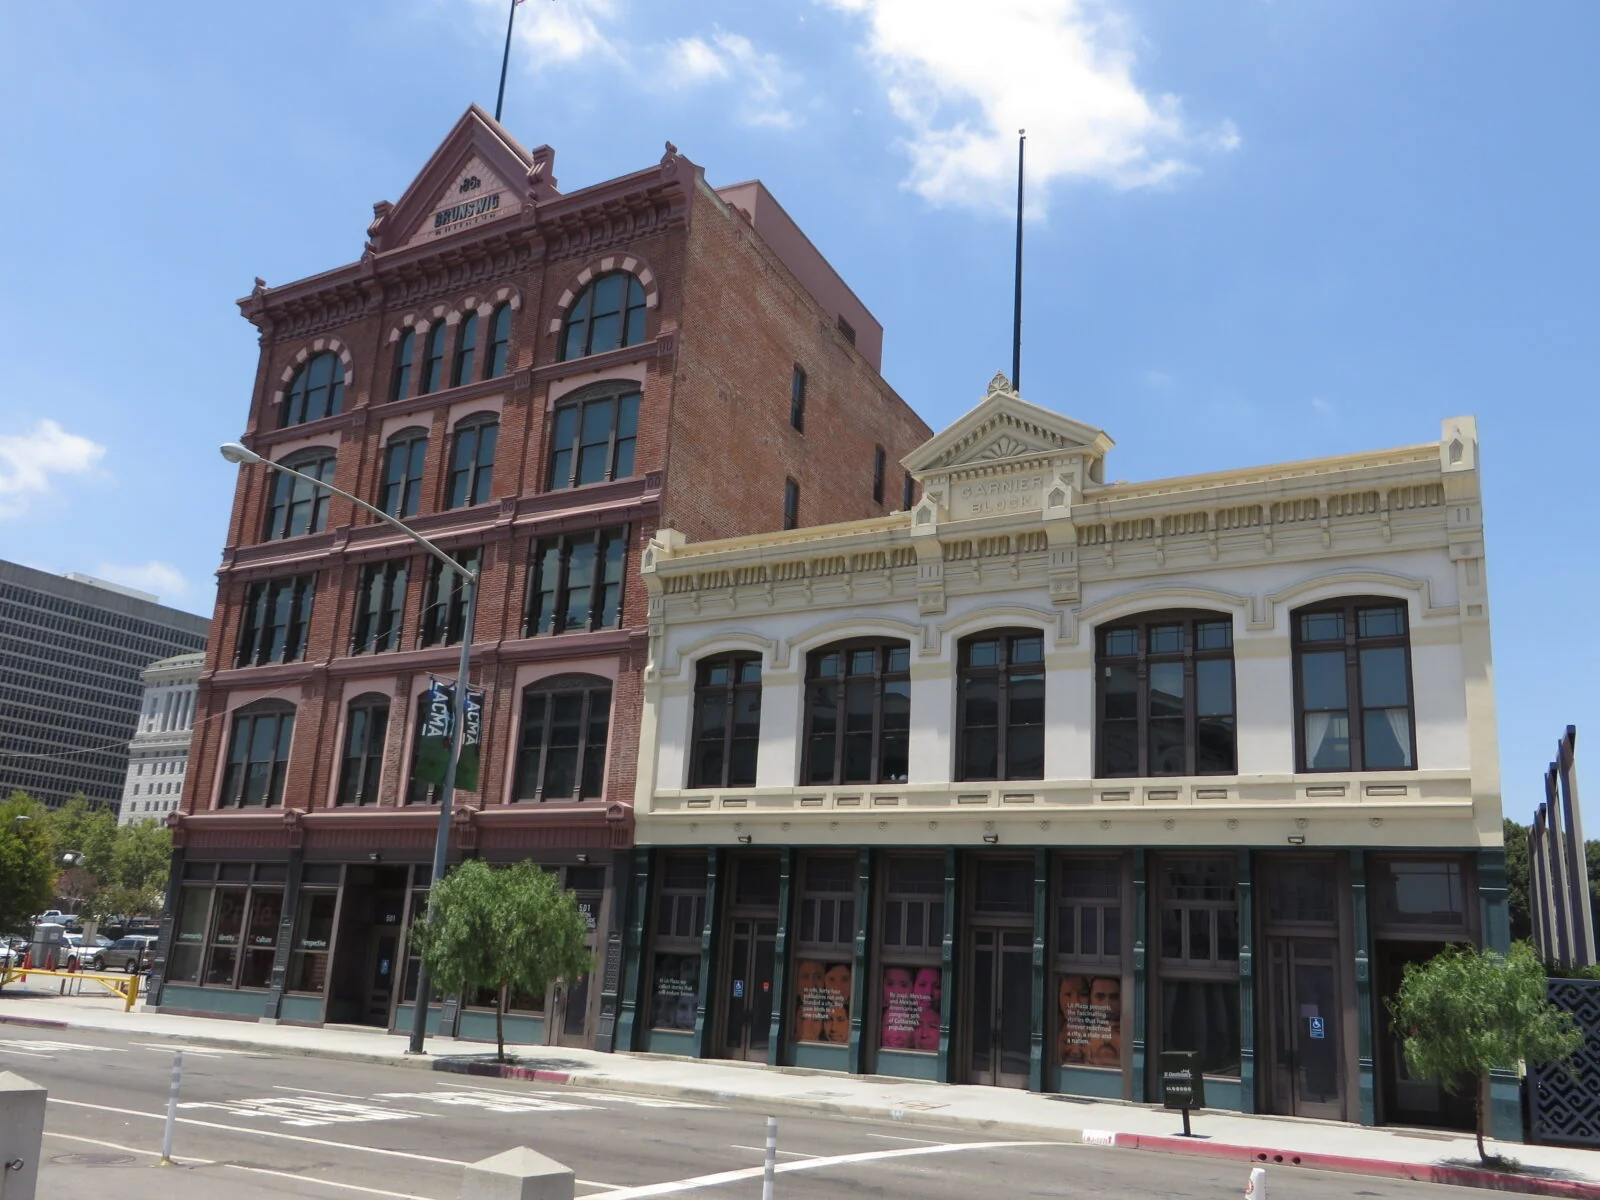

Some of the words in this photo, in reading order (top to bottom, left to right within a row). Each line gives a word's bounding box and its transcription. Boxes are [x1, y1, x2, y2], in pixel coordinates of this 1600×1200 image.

[434, 194, 500, 228] BRUNSWIG
[962, 476, 1042, 498] GARNIER
[972, 496, 1031, 512] BLOCK
[427, 682, 448, 736] LACMA
[465, 691, 481, 745] LACMA
[578, 904, 590, 912] 501
[256, 935, 272, 943] Culture
[1076, 1009, 1106, 1019] fascinating
